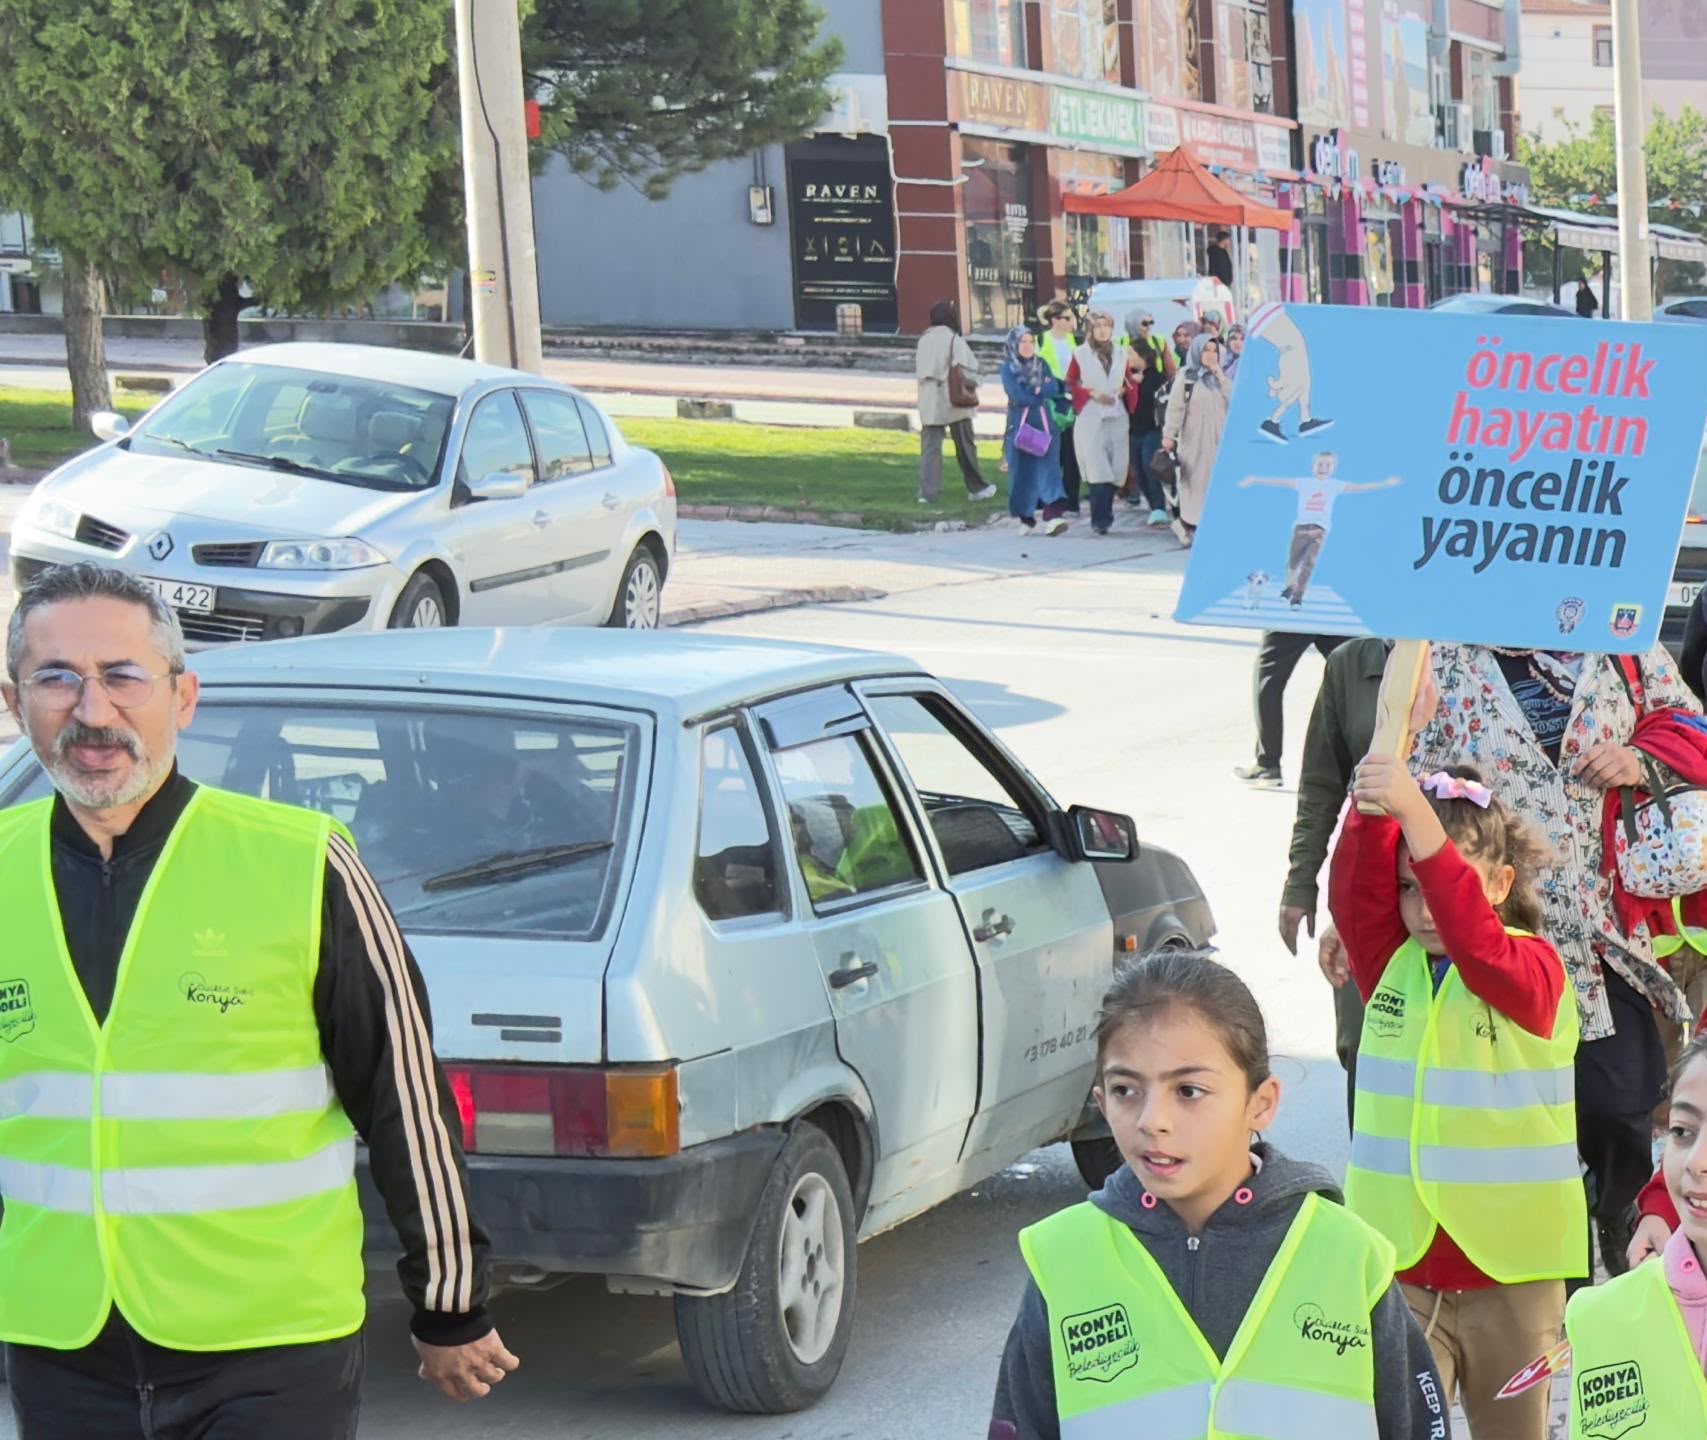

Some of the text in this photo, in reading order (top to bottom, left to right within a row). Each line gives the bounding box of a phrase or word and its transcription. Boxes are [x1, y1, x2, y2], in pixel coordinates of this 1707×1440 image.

[970, 78, 1027, 115] RAVEN
[806, 184, 877, 198] RAVEN
[1466, 335, 1658, 400] öncelik
[1446, 392, 1649, 465] hayatın
[1438, 452, 1630, 517] öncelik
[1413, 516, 1628, 575] yayanın
[173, 586, 209, 607] 422
[187, 985, 246, 1014] Konya
[1068, 1310, 1125, 1341] KONYA
[1302, 1317, 1366, 1356] Konya
[1416, 1371, 1441, 1415] KEEP
[1583, 1366, 1638, 1396] KONYA
